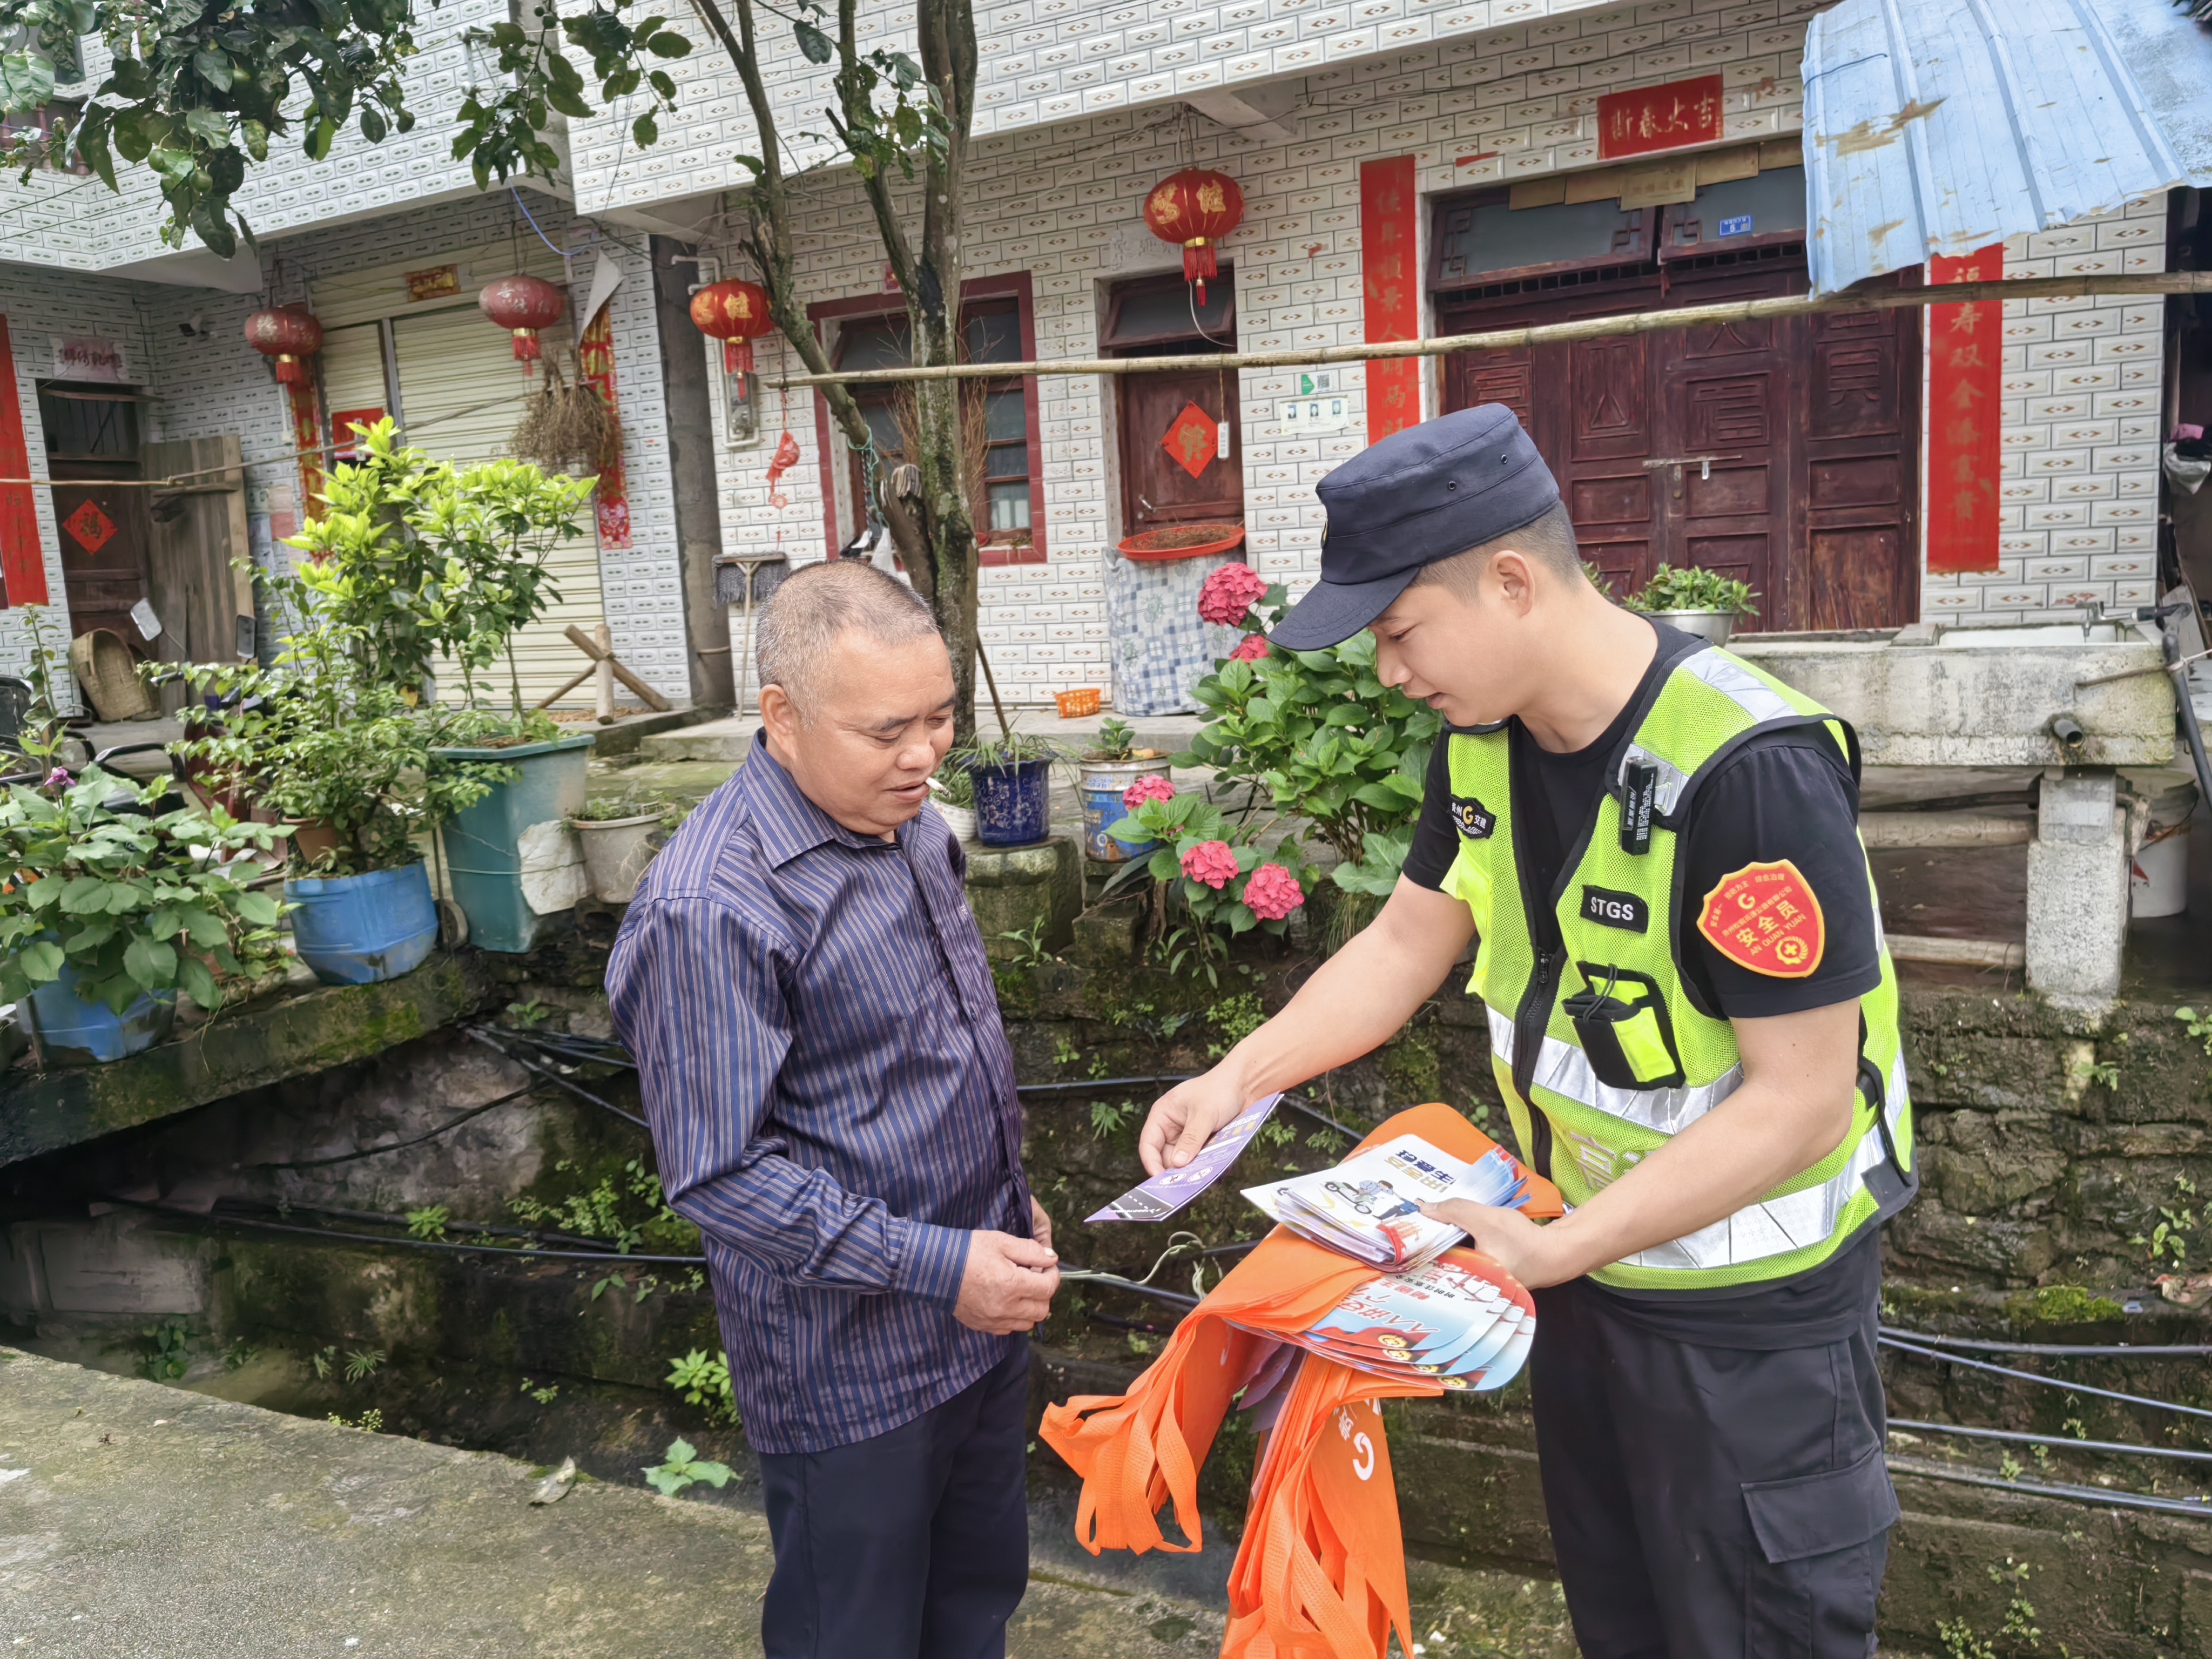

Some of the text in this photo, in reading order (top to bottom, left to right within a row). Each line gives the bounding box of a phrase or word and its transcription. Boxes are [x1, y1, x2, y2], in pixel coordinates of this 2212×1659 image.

[1452, 802, 1463, 817] 贵州
[1474, 814, 1487, 829] 交建
[1723, 880, 1750, 900] 预防为主
[1754, 873, 1785, 884] 综合治理
[1590, 896, 1635, 921] STGS
[1736, 900, 1799, 948] 安全员
[1750, 913, 1806, 956] AN QUAN YUAN
[1395, 1149, 1456, 1185] 珍爱生
[1337, 1297, 1440, 1333] 人人讲安
